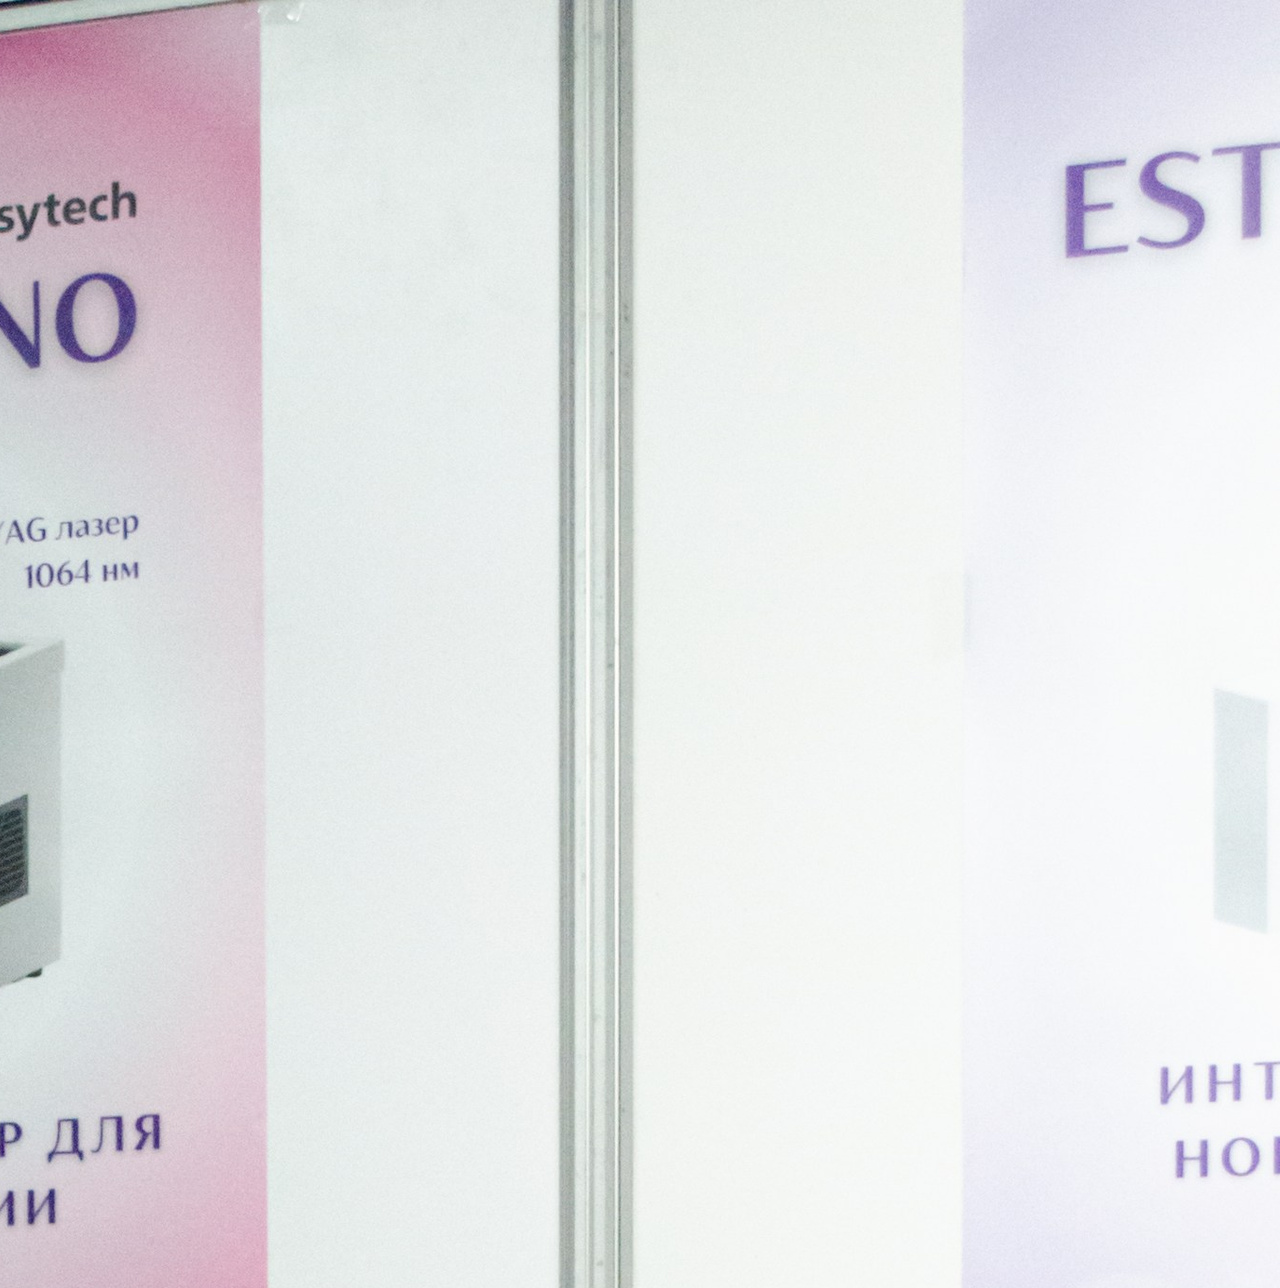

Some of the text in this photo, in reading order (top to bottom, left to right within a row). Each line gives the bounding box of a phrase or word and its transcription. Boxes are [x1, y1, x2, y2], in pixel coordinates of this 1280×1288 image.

[1065, 142, 1280, 258] EST
[54, 513, 139, 546] лазер
[25, 559, 140, 590] 1064 нм
[1160, 1061, 1280, 1105] ИНТ
[47, 1113, 164, 1160] ДЛЯ
[1176, 1136, 1280, 1178] НО
